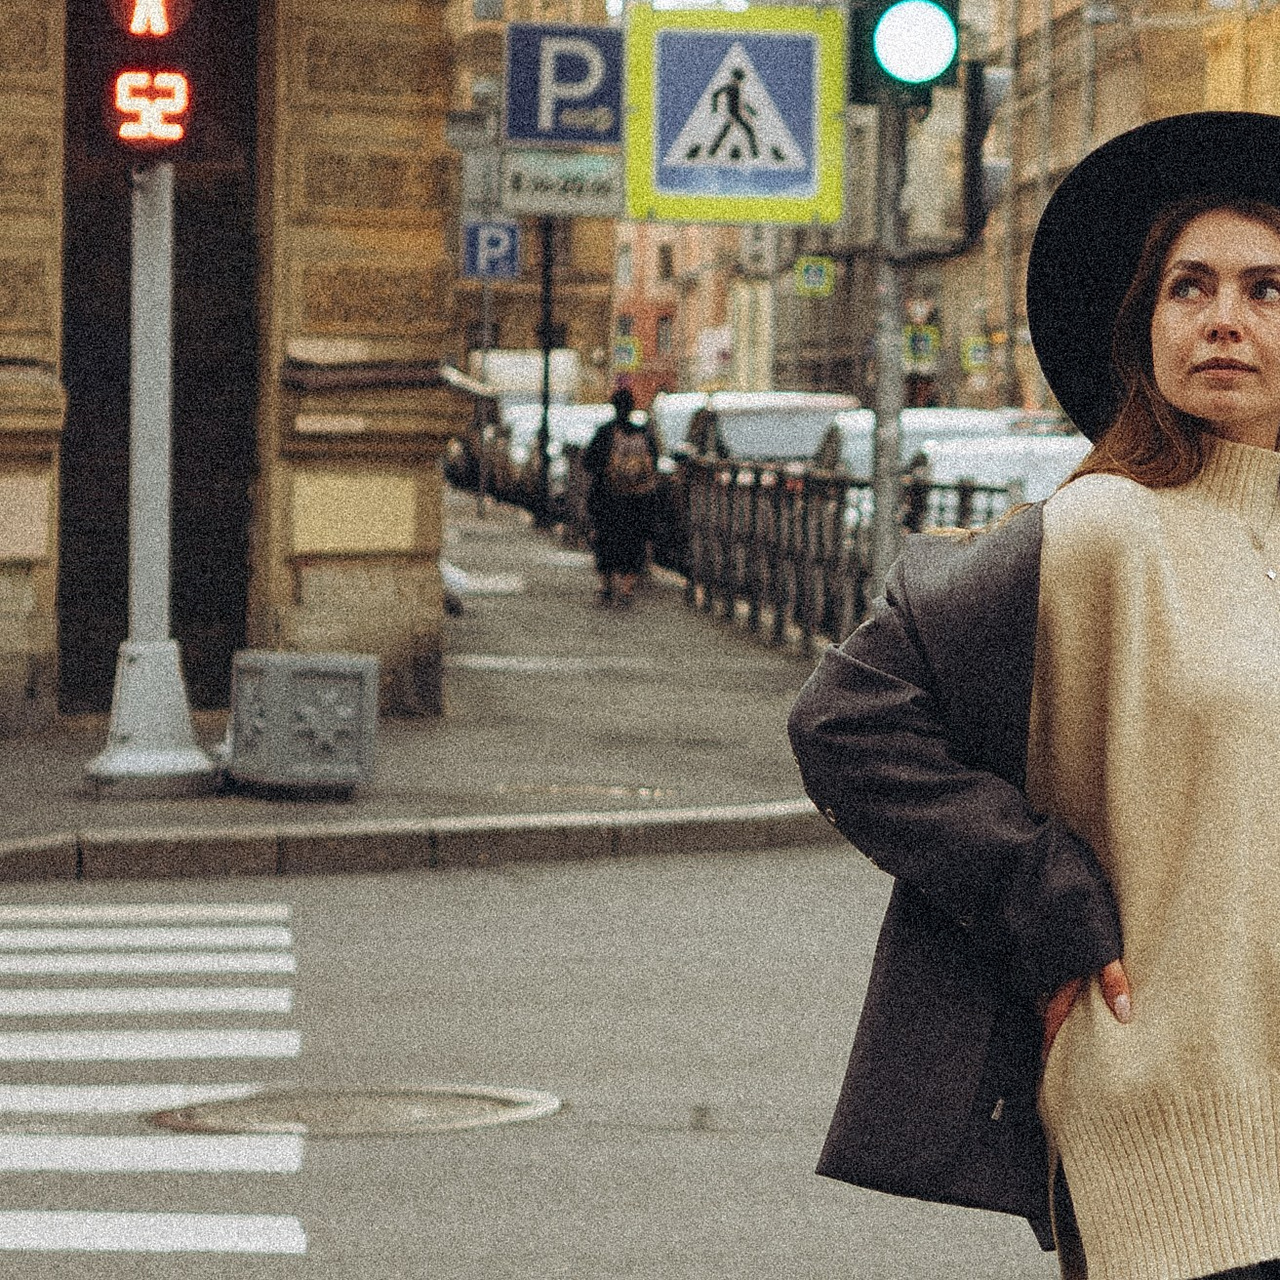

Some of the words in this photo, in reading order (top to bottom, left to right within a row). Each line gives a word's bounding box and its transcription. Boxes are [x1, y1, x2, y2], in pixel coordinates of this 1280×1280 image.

[115, 70, 189, 140] 52
[537, 35, 606, 132] P
[476, 226, 511, 273] P
